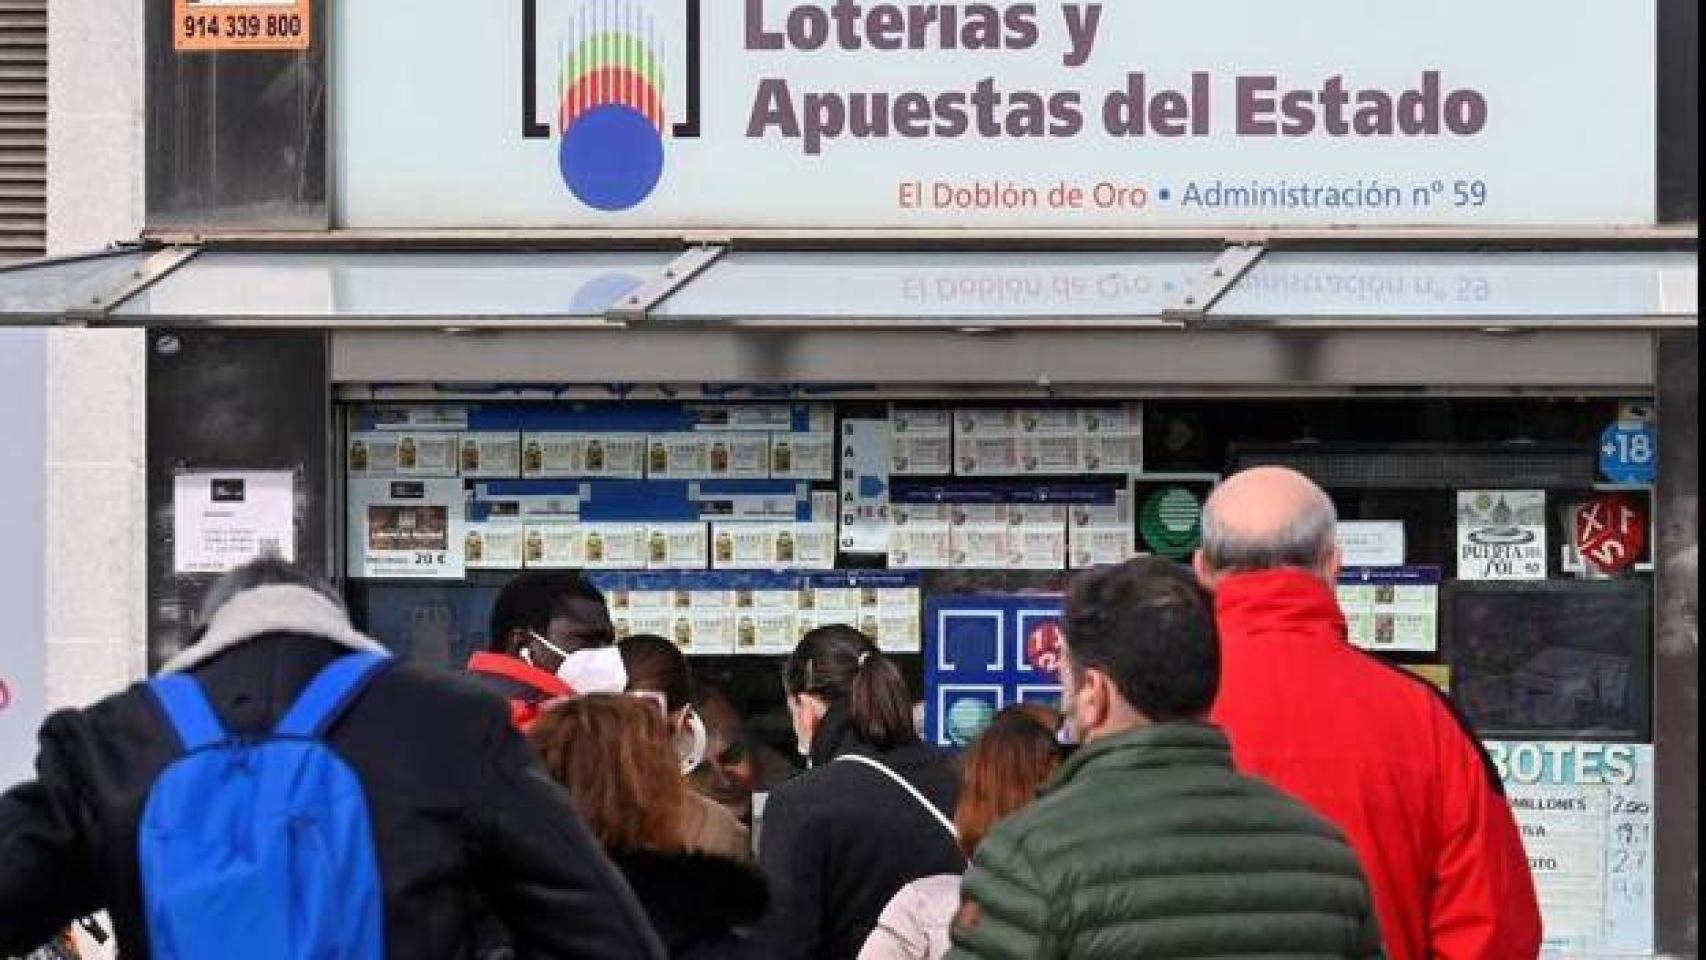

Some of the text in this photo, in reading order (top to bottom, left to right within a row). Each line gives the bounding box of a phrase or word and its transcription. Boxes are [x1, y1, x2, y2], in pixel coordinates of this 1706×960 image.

[185, 15, 301, 37] 914 339 800
[1062, 2, 1103, 67] y
[746, 71, 1488, 155] Apuestas del Estado
[899, 180, 1487, 208] El Doblón de Oro Administración nº 59
[1602, 433, 1652, 463] +18
